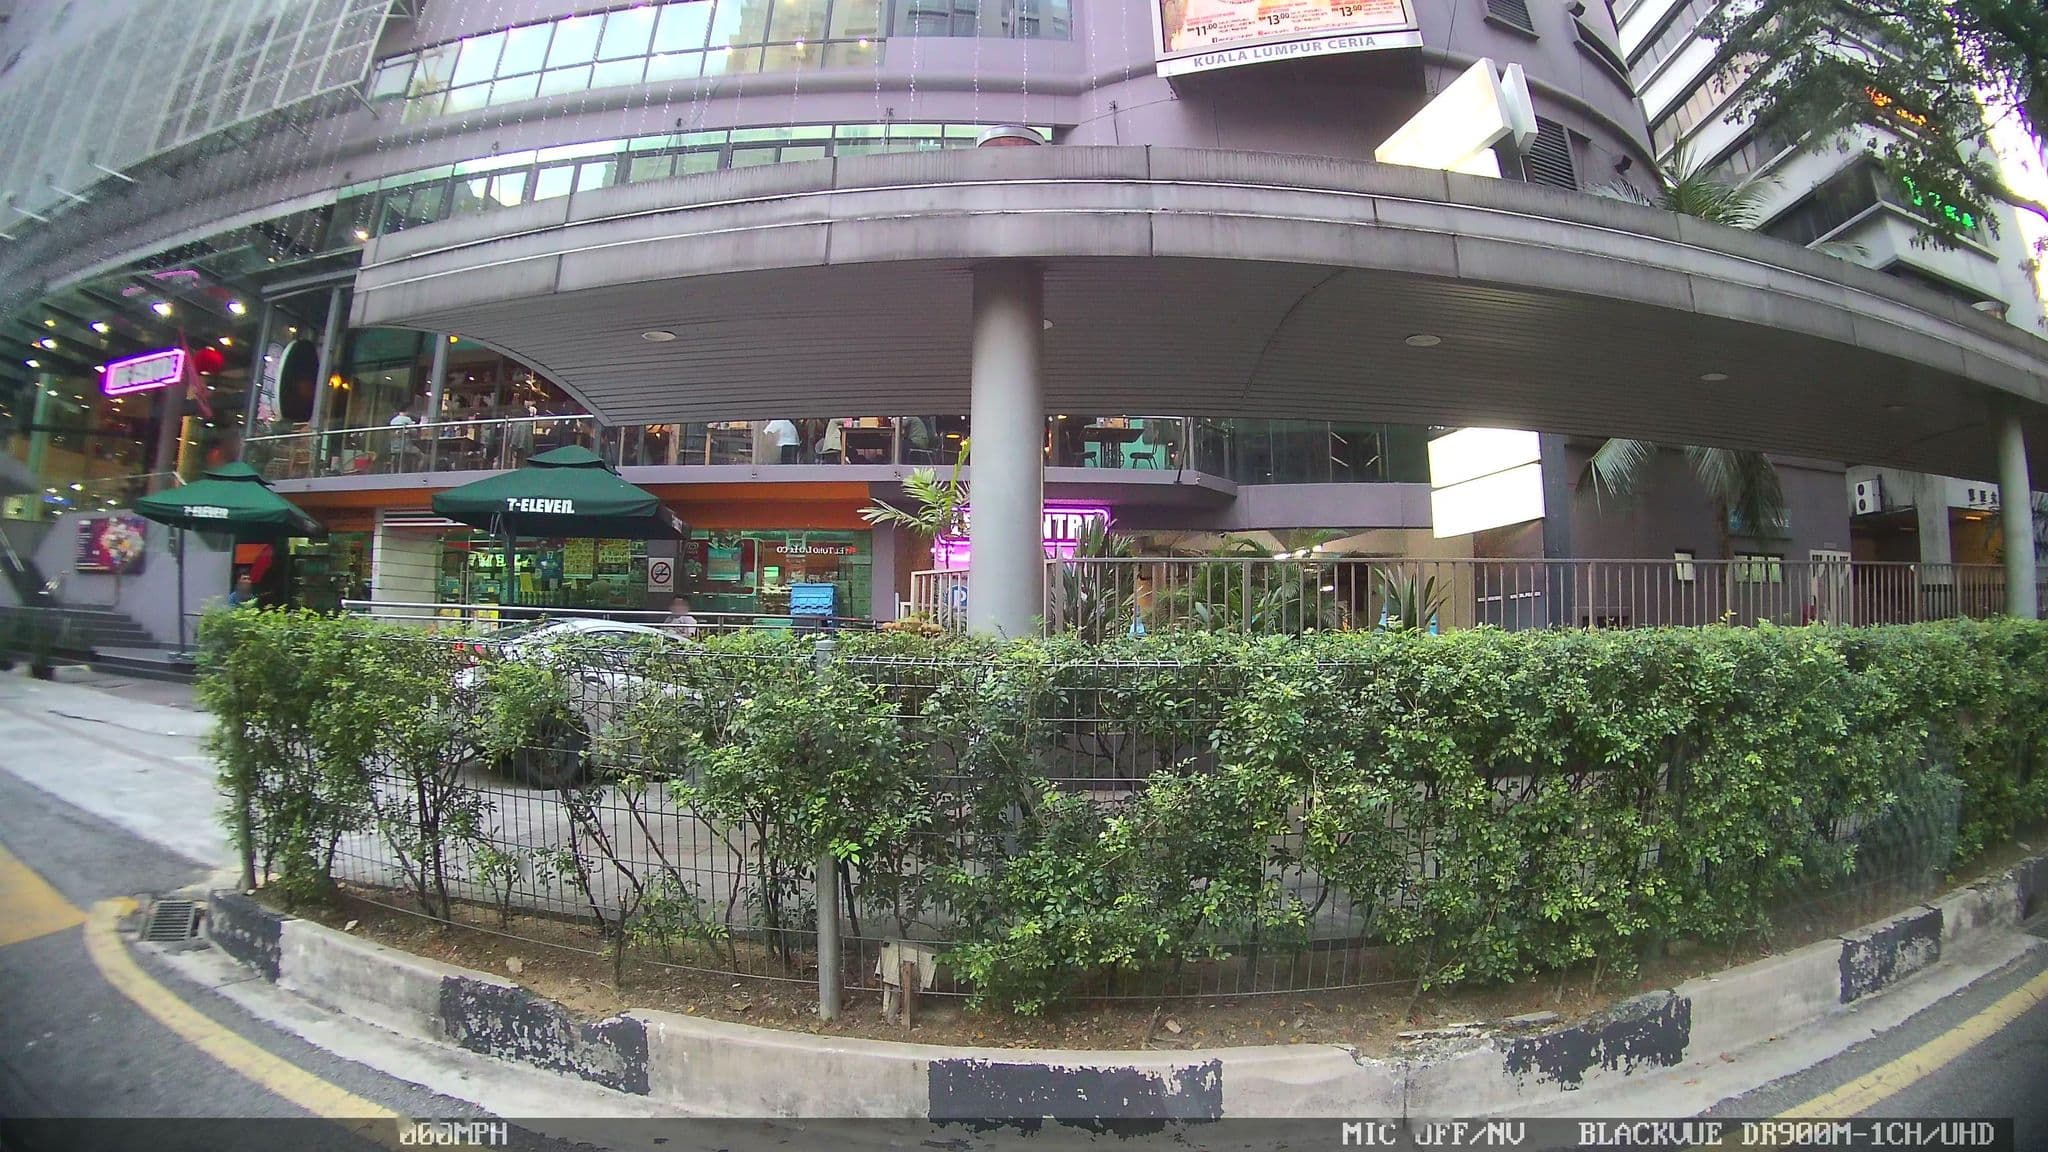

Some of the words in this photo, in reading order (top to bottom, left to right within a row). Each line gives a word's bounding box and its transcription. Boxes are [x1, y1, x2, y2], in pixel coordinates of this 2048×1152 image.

[1194, 51, 1248, 67] KUALA
[1254, 41, 1322, 58] LUMPUR
[1328, 36, 1376, 49] CERIA
